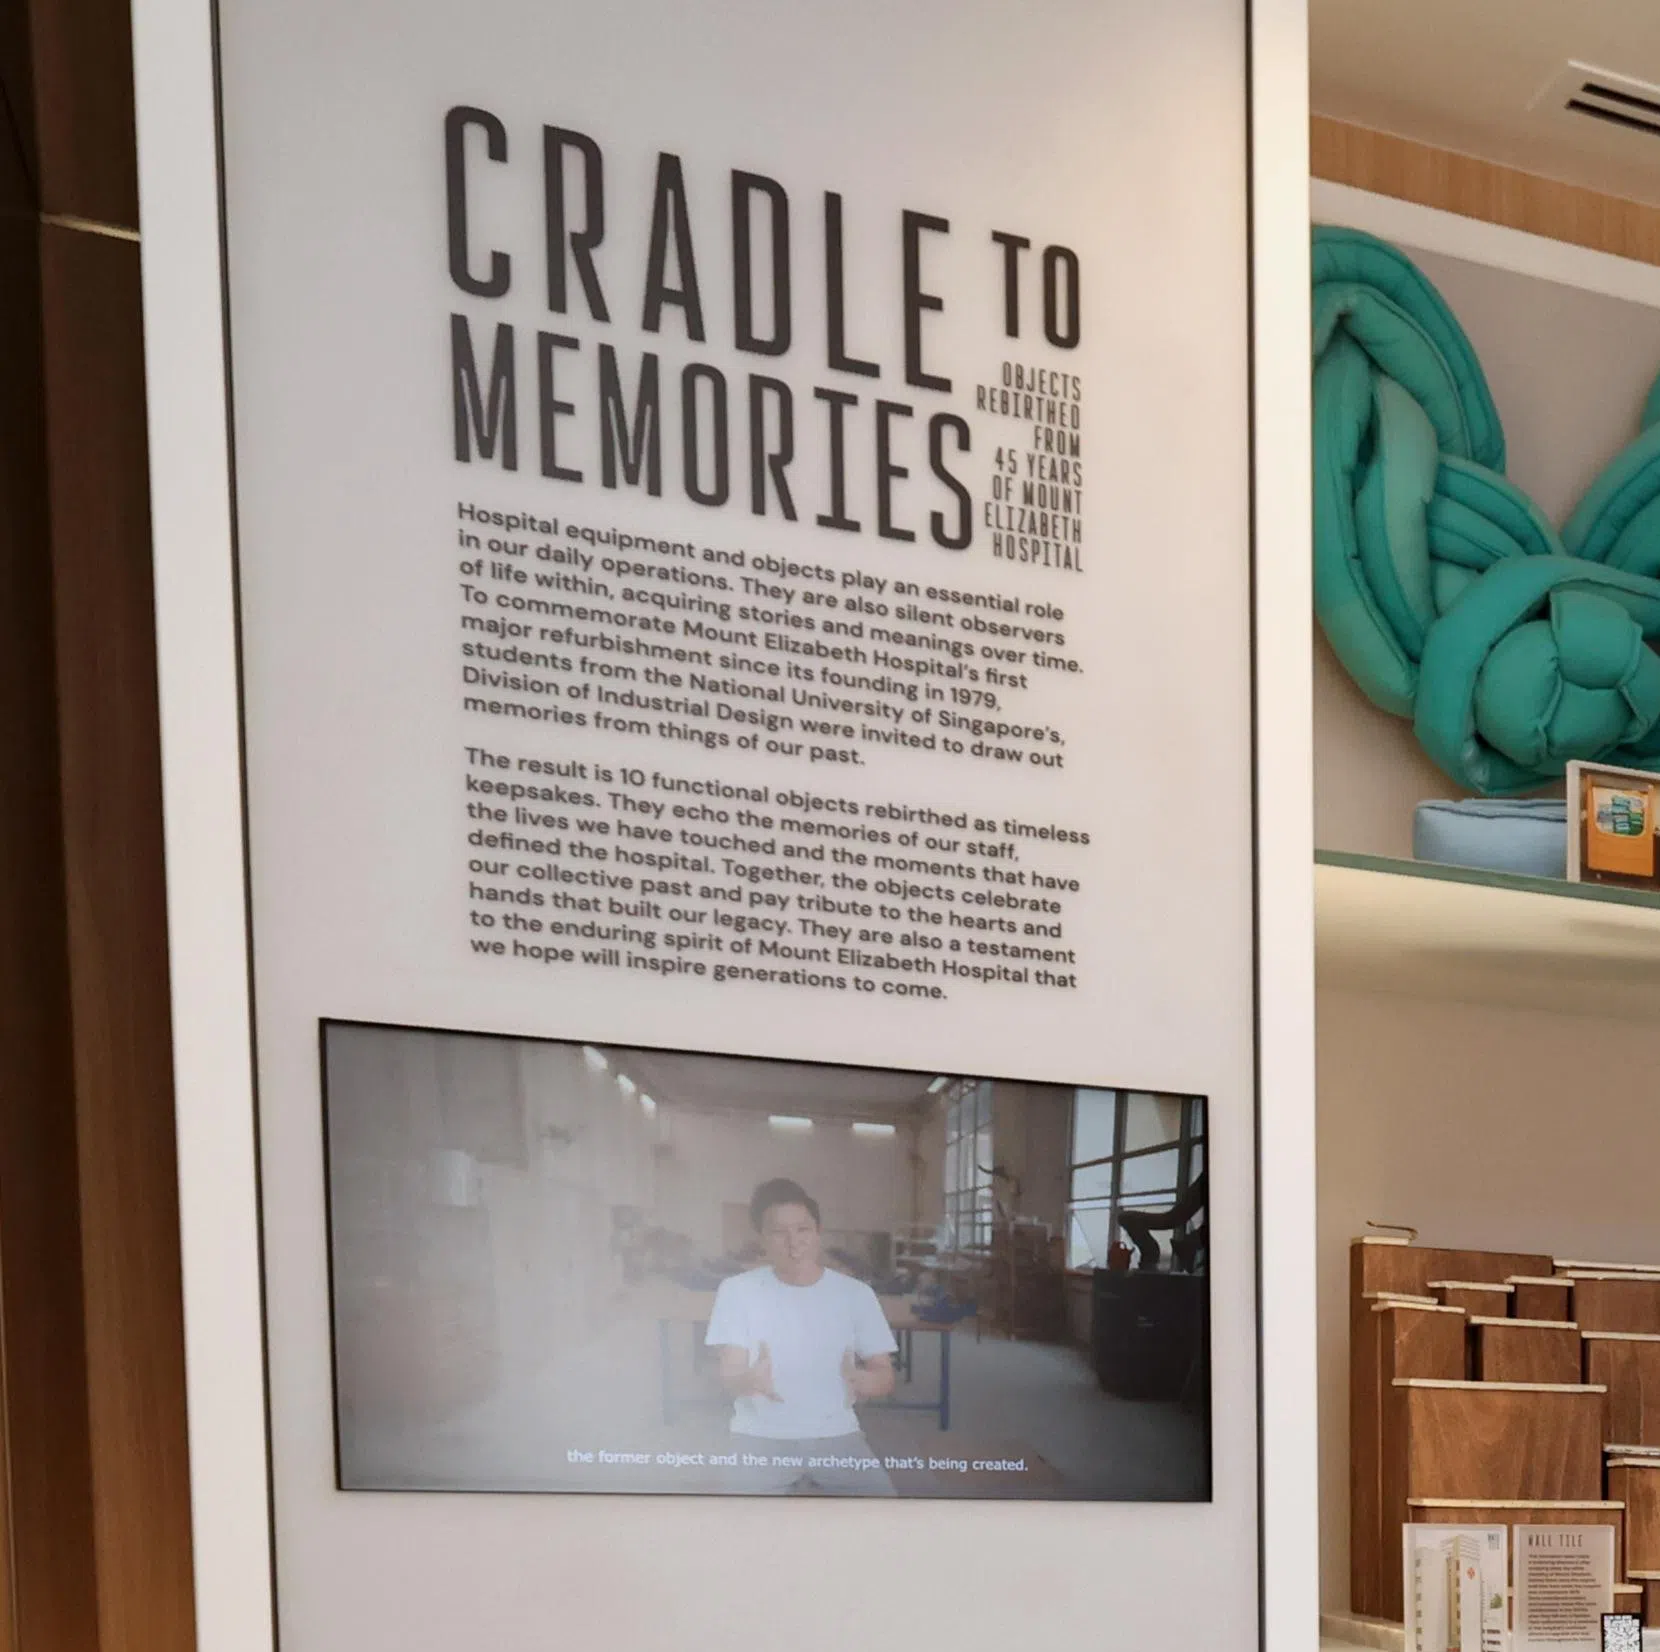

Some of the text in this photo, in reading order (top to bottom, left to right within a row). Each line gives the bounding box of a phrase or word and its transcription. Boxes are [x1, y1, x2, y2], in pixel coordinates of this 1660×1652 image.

[443, 103, 1081, 393] CRADLE TO
[976, 384, 1080, 430] REBIRTHED
[1002, 361, 1081, 402] OBJECTS
[448, 312, 974, 552] MEMORIES
[995, 446, 1083, 487] 45 YEARS
[1034, 425, 1080, 458] FROM
[985, 501, 1082, 544] ELIZABETH
[992, 475, 1082, 515] OF MOUNT
[457, 501, 1065, 622] Hospital equipment and objects play an essential role
[458, 528, 1066, 647] in our daily operations. They are also silent observers
[993, 531, 1084, 573] HOSPITAL
[459, 583, 1028, 690] To commemorate Mount Elizabeth Hospital's first
[461, 615, 1001, 712] major refurbishment since its founding in 1979,
[462, 642, 1065, 747] students from the National University of Singapore's,
[462, 665, 1064, 769] Division of Industrial Design were invited to draw out
[463, 696, 865, 765] memories from things of our past.
[464, 746, 1091, 846] The result is 10 functional objects rebirthed as timeless
[465, 773, 1019, 862] keepsakes. They echo the memories of our staff,
[466, 801, 1080, 893] the lives we have touched and the moments that have
[467, 828, 1062, 915] defined the hospital. Together, the objects celebrate
[468, 859, 1062, 939] our collective past and pay tribute to the hearts and
[469, 881, 1076, 965] hands that built our legacy. They are also a testament
[470, 939, 948, 1000] we hope will inspire generations to come.
[567, 1449, 1029, 1472] the former object and the new archetype that's being created.
[1559, 1534, 1583, 1547] TILE
